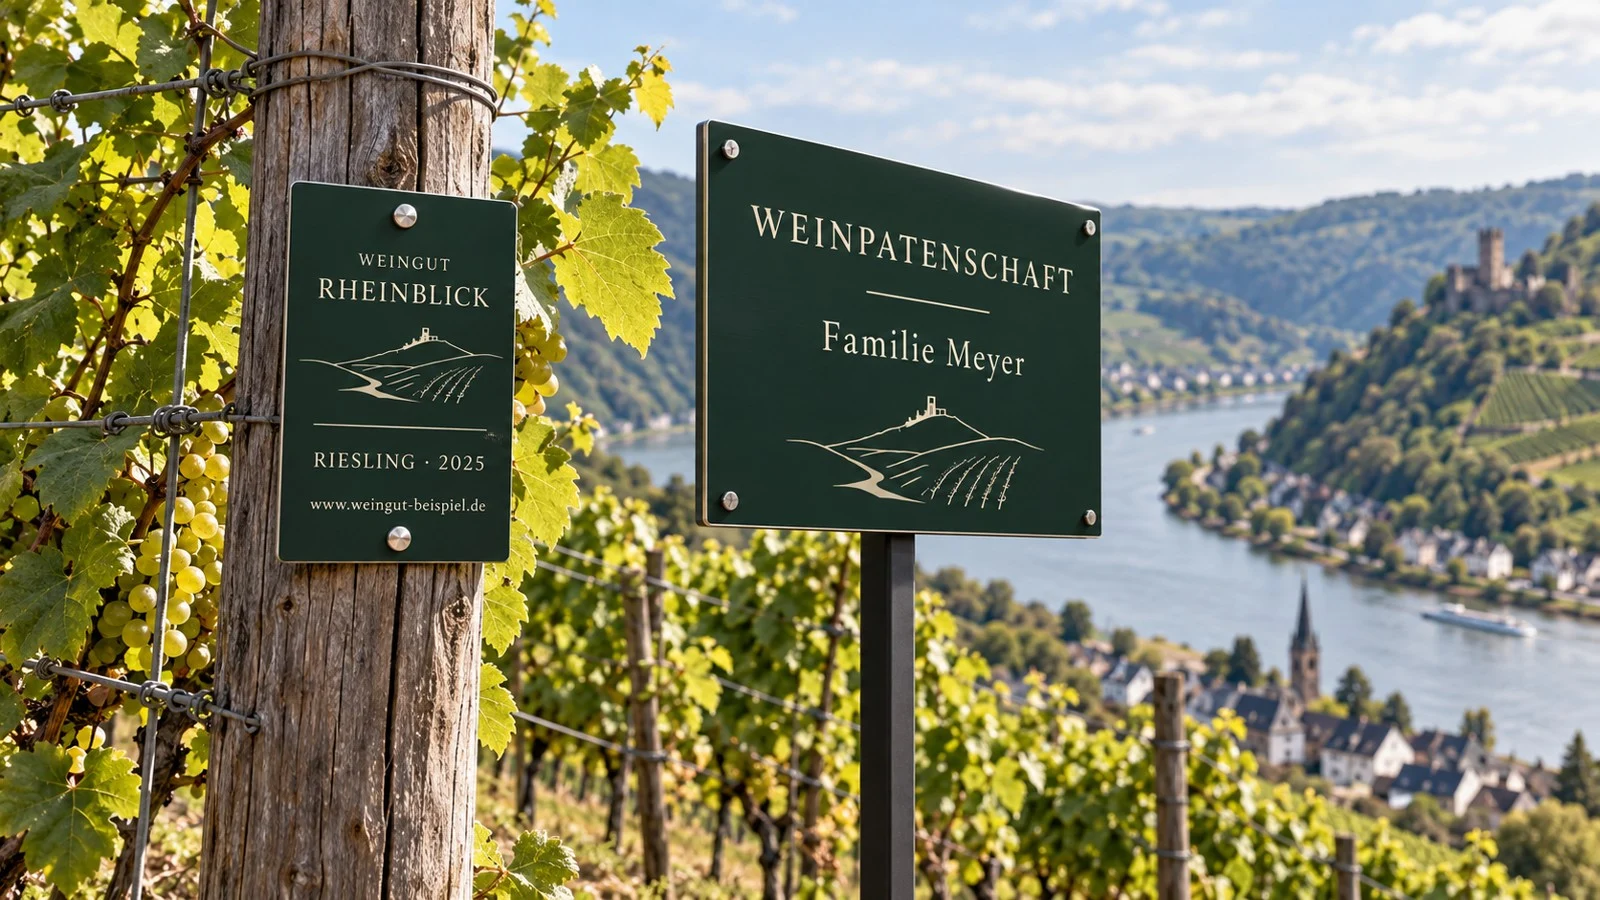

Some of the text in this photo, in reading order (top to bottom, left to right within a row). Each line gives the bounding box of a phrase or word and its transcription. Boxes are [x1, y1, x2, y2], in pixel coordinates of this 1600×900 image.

[358, 252, 451, 272] WEINGUT
[750, 204, 1074, 295] WEINPATENSCHAFT
[318, 277, 490, 308] RHEINBLICK
[822, 319, 1025, 383] Familie Meyer
[313, 451, 415, 470] RIESLING
[438, 454, 485, 472] 2025
[310, 497, 487, 516] www.weingut-beispiel.de
